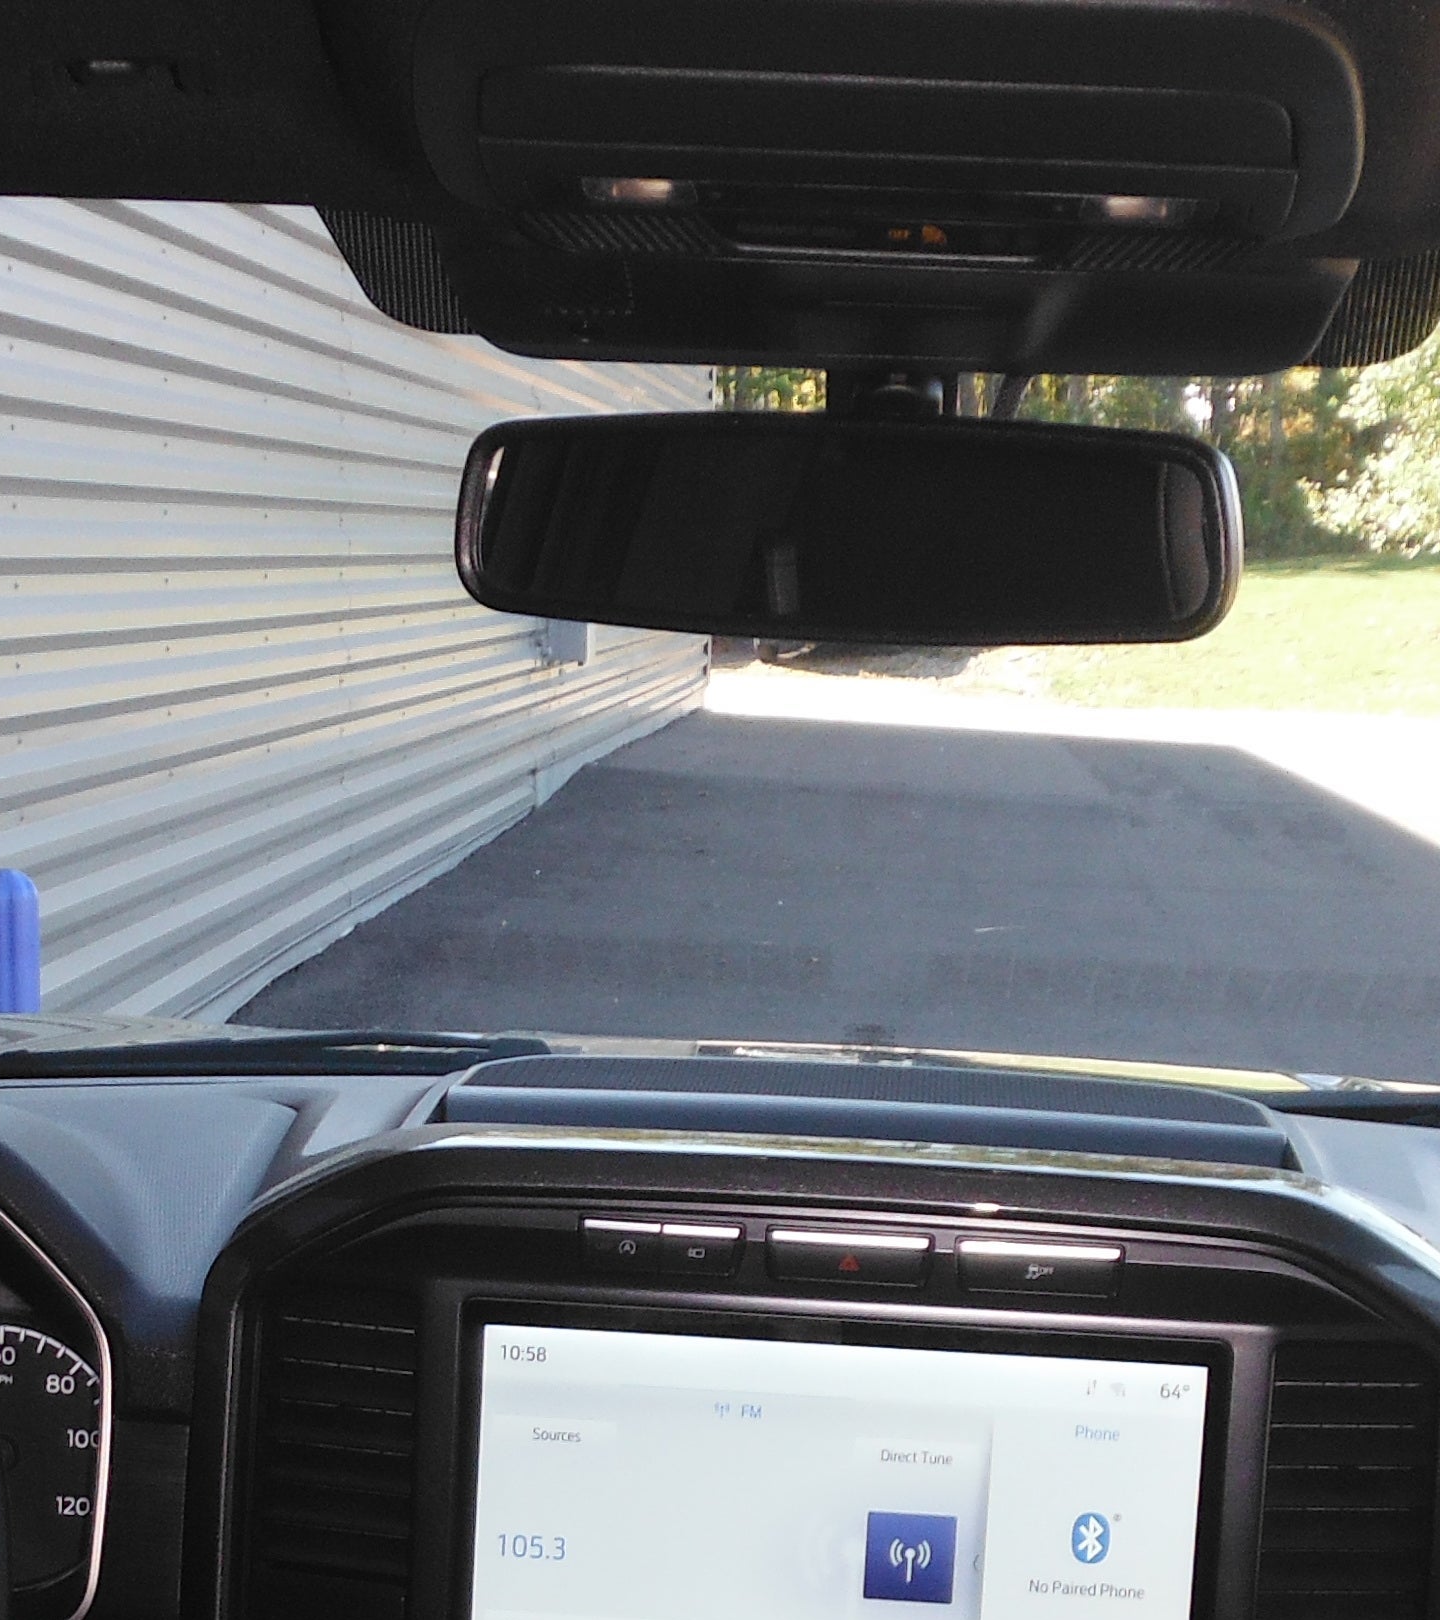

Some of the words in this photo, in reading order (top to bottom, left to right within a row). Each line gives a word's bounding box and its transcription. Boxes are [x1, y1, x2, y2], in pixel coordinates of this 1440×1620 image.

[500, 1344, 547, 1363] 10:58
[45, 1374, 75, 1395] 80
[741, 1404, 763, 1419] FM
[532, 1427, 582, 1444] Sources
[1074, 1426, 1121, 1444] Phone
[879, 1448, 916, 1466] Direct
[919, 1450, 953, 1467] Tune
[56, 1495, 90, 1516] 120
[497, 1534, 566, 1561] 105.3
[1028, 1578, 1048, 1596] No
[1051, 1580, 1096, 1599] Paired
[1099, 1581, 1146, 1600] Phone
